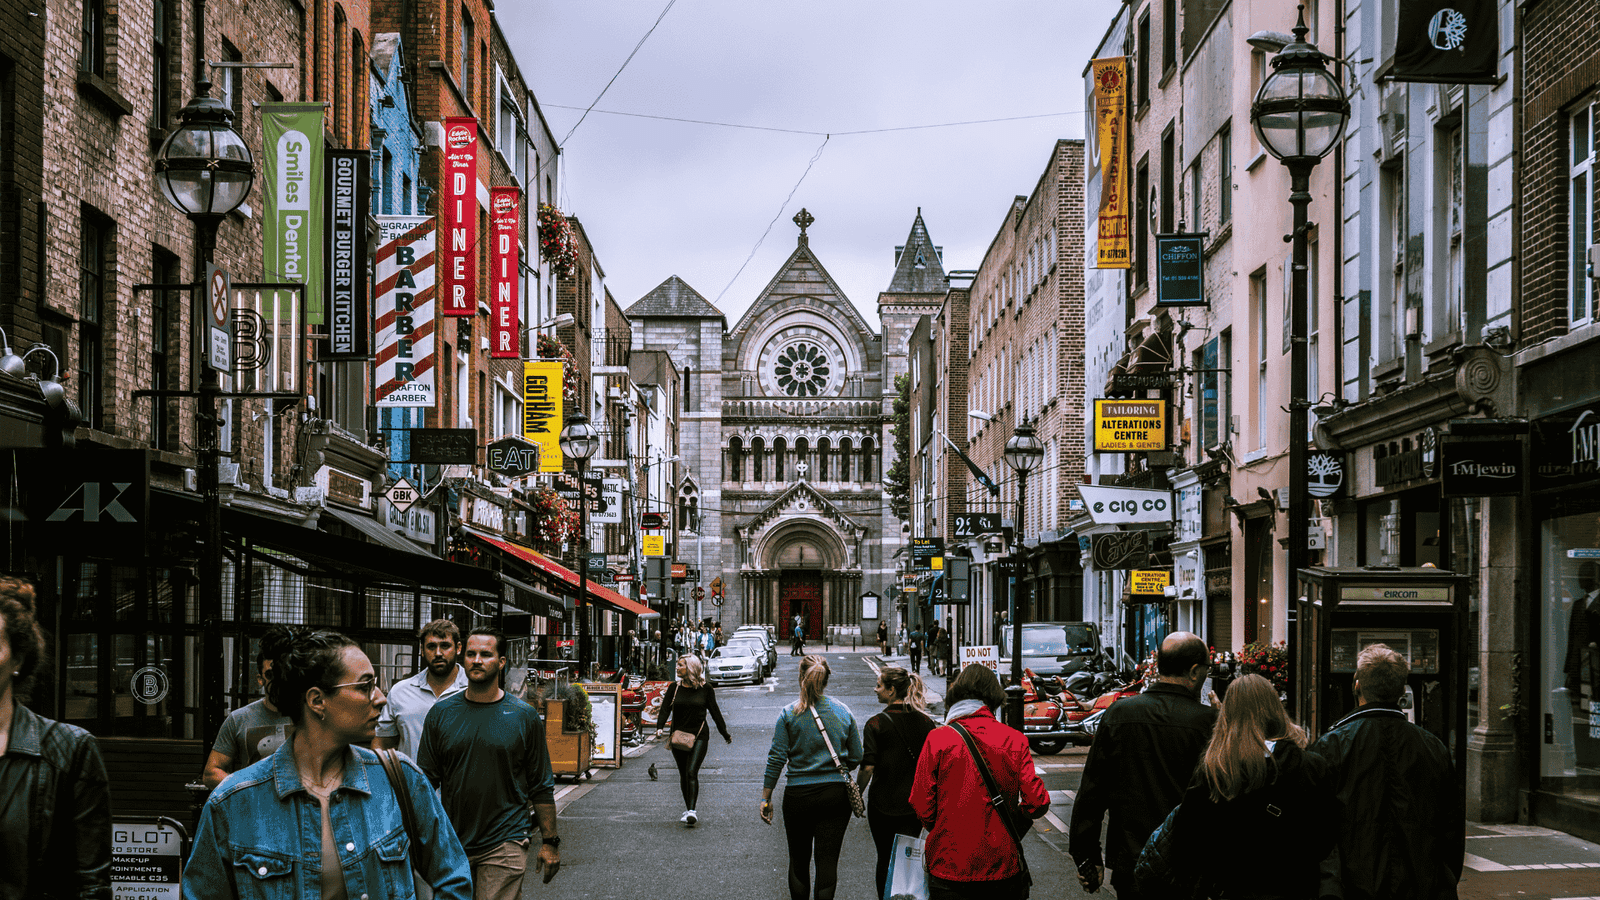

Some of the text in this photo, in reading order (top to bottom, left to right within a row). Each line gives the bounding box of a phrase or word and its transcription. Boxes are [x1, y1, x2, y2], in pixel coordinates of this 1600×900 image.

[284, 142, 304, 283] Smiles Dental
[388, 222, 432, 230] GRAFTON
[390, 232, 428, 241] BARBER
[452, 172, 466, 308] DINER
[335, 157, 352, 353] GOURMET BURGER KITCHEN
[498, 234, 511, 351] DINER
[394, 246, 416, 382] BARBER
[388, 384, 430, 392] GRAFTON
[389, 394, 426, 402] BARBER
[526, 375, 556, 434] GOTHAM
[1107, 406, 1156, 415] TAILORING
[1102, 420, 1162, 429] ALTERATIONS
[1114, 431, 1148, 440] CENTRE
[490, 446, 534, 470] EAT
[583, 472, 601, 480] INES
[558, 473, 598, 498] KEHES
[393, 491, 412, 500] GBK
[1093, 499, 1166, 516] e cig co
[966, 648, 991, 657] DO NOT
[982, 660, 997, 669] THIS
[144, 674, 158, 696] B
[115, 831, 173, 844] GLOT
